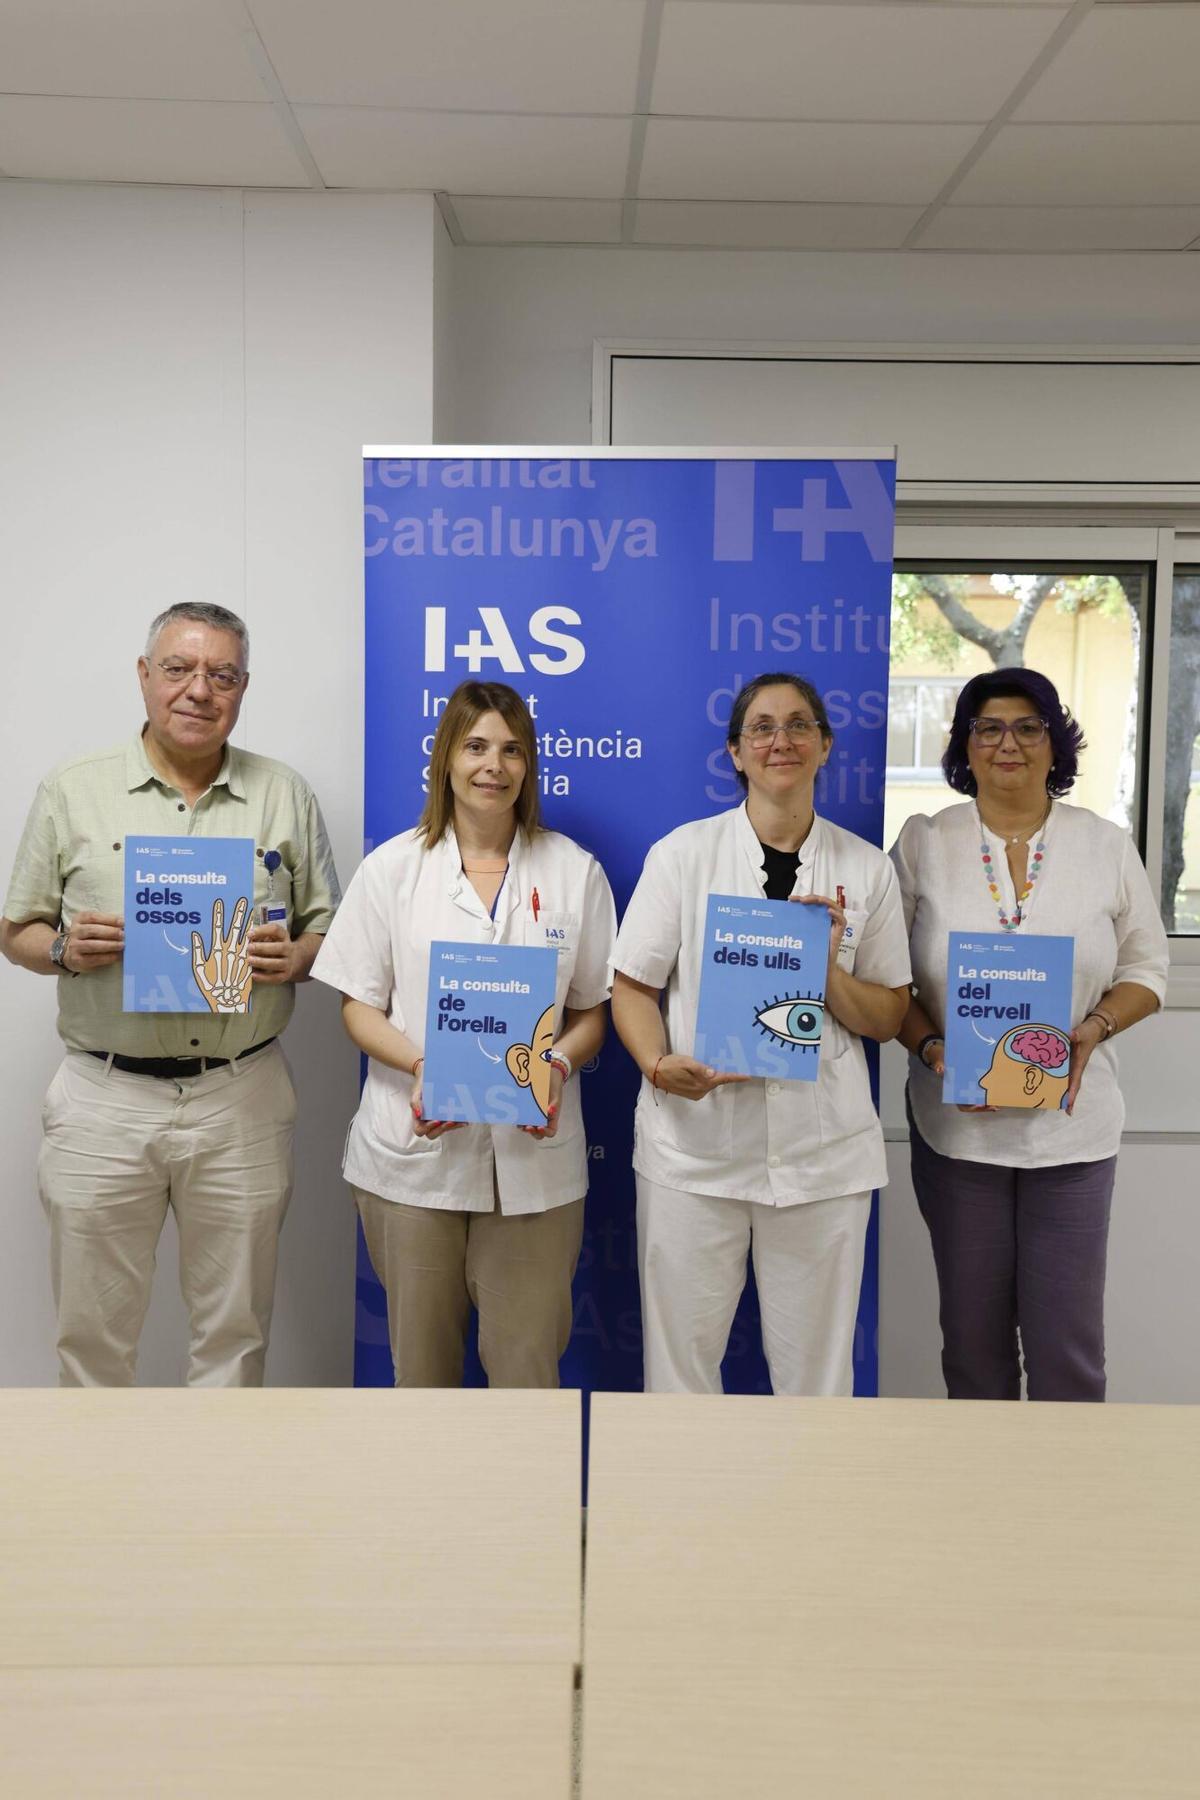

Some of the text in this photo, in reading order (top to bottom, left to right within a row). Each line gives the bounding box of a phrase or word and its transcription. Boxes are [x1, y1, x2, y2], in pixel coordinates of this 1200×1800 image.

[364, 504, 659, 571] Catalunya
[136, 870, 227, 885] La consulta
[136, 887, 183, 906] dels
[136, 909, 202, 925] ossos
[715, 928, 804, 950] La consulta
[713, 946, 801, 971] dels ulls
[958, 965, 1047, 982] La consulta
[440, 975, 530, 994] La consulta
[958, 982, 991, 1000] del
[438, 993, 466, 1012] de
[957, 1003, 1031, 1020] cervell
[437, 1013, 508, 1034] l'orella
